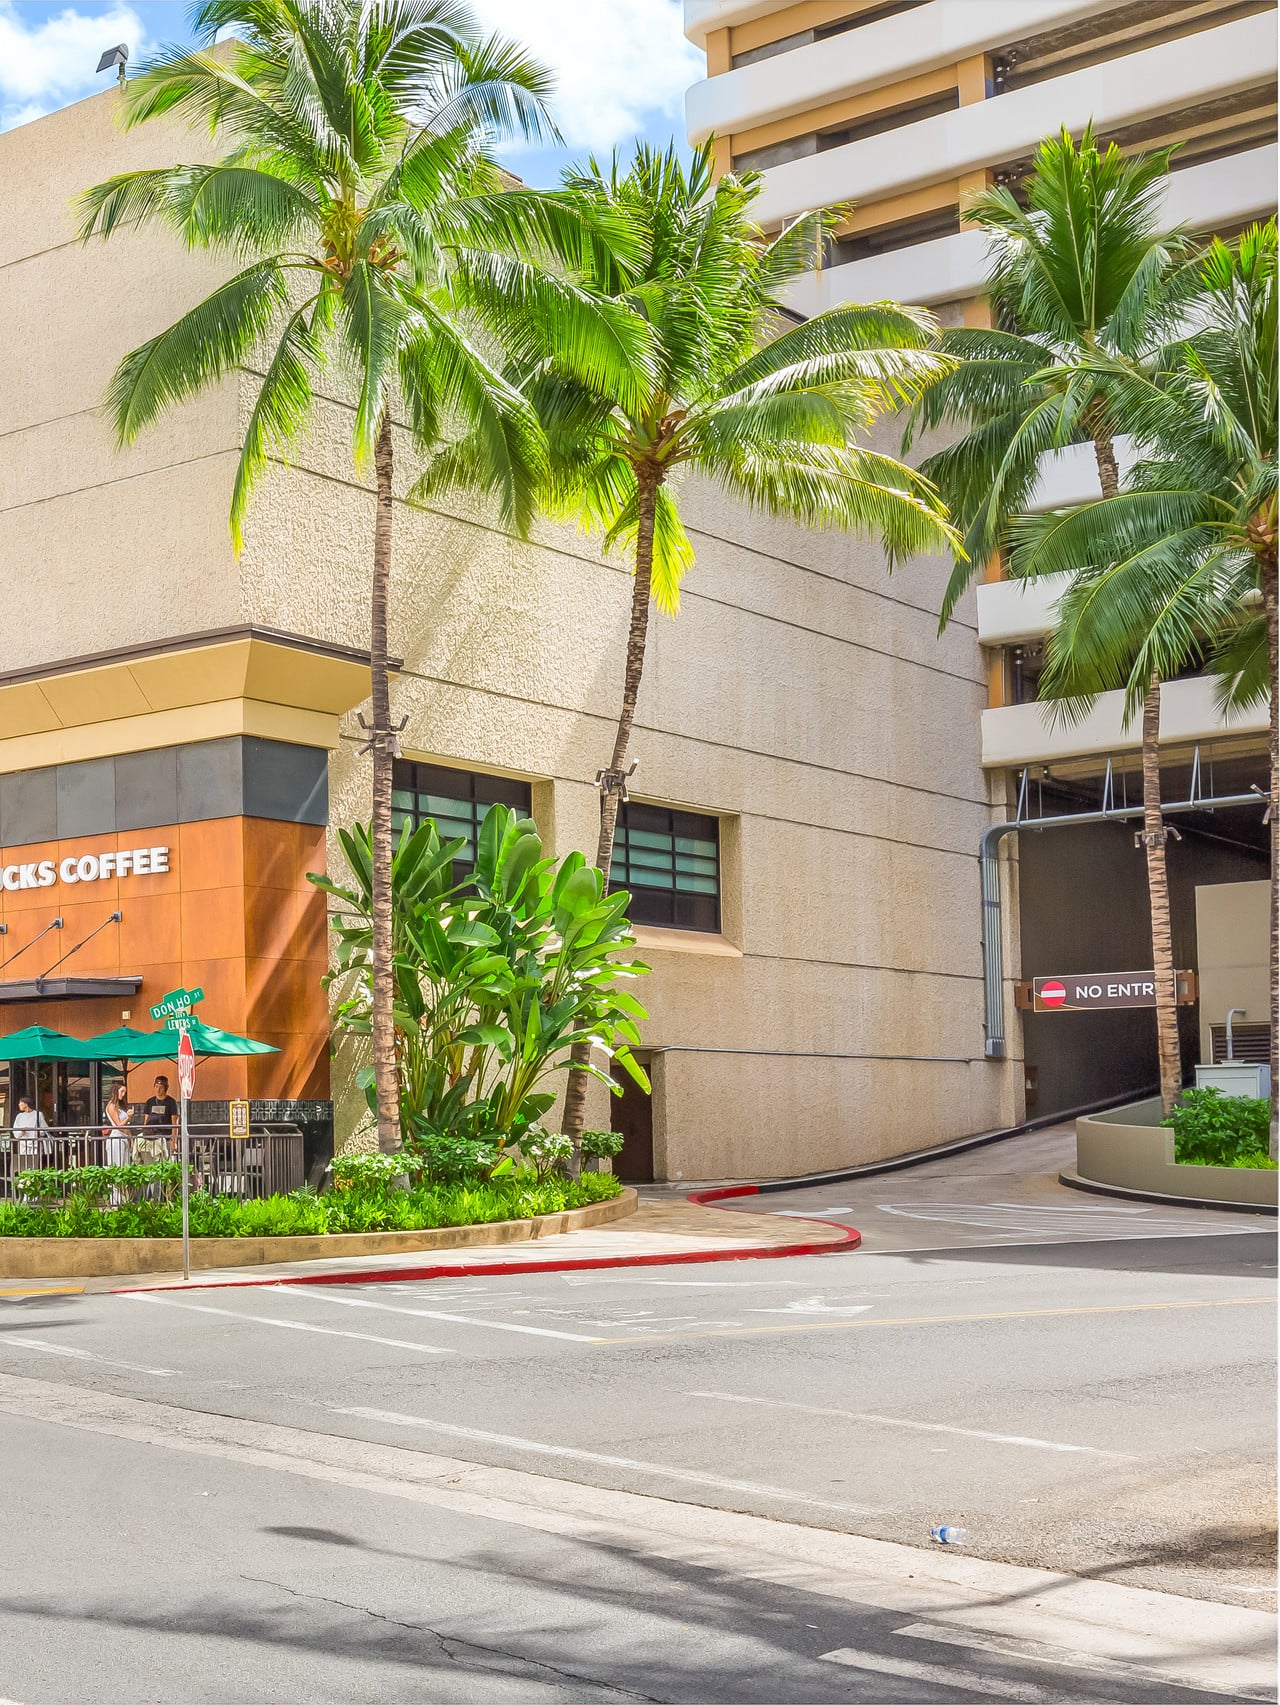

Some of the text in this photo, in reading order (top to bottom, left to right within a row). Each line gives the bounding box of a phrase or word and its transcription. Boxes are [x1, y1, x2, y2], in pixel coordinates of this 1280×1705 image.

[59, 846, 171, 884] COFFEE
[1075, 982, 1156, 999] NO ENTR
[153, 1001, 176, 1018] DON
[176, 994, 191, 1009] HO
